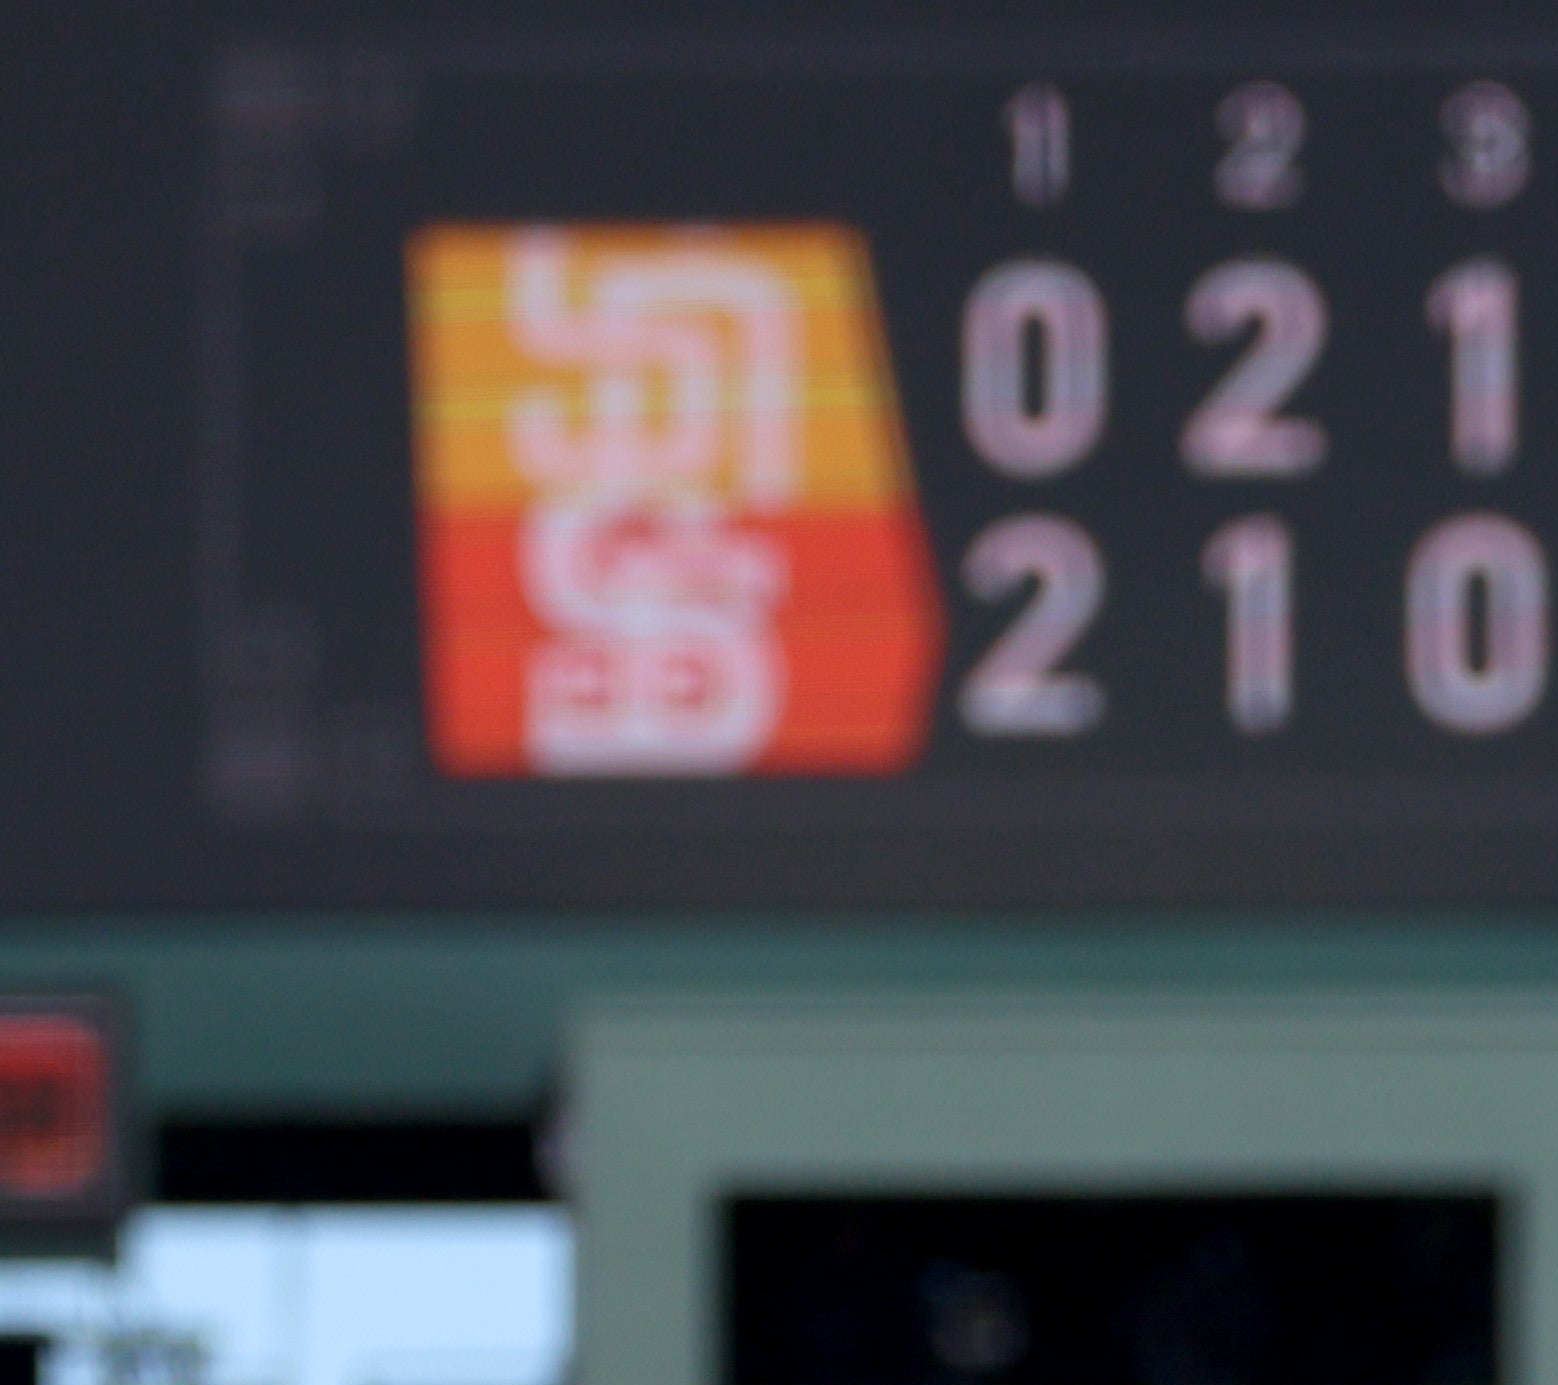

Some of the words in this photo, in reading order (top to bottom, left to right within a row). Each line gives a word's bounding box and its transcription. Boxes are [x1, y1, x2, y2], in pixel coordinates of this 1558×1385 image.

[1008, 84, 1070, 202] 1
[1217, 84, 1303, 204] 2
[1443, 82, 1528, 202] 3
[962, 261, 1109, 477] 0
[1184, 261, 1326, 475] 2
[1427, 263, 1518, 469] 1
[961, 516, 1104, 735] 2
[1205, 519, 1294, 728] 1
[1405, 515, 1549, 732] 0
